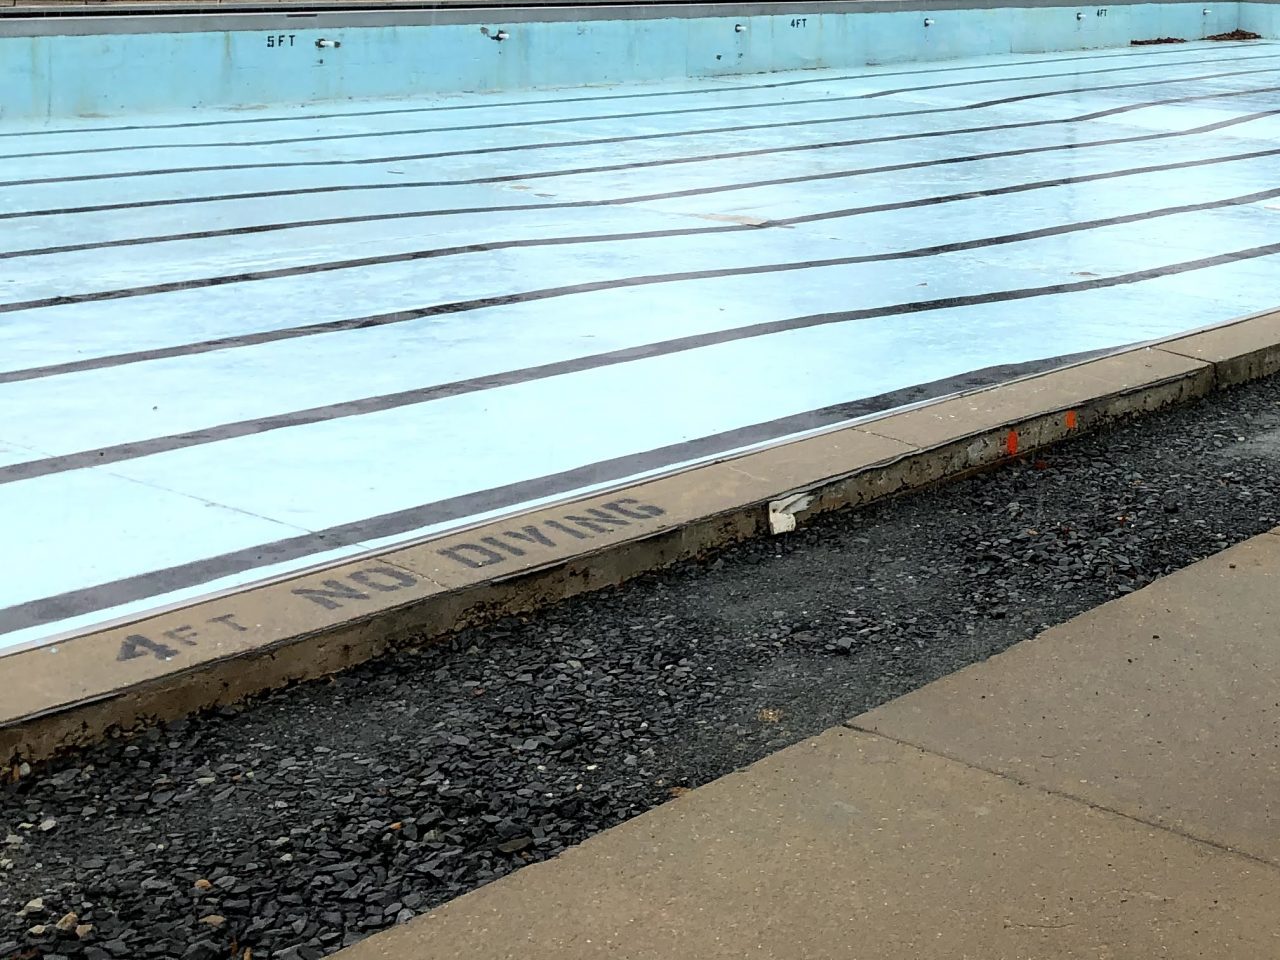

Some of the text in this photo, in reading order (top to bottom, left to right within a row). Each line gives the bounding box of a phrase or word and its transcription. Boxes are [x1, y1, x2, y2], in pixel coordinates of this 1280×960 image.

[1095, 8, 1108, 16] 4FT
[790, 17, 808, 29] 4FT
[267, 35, 295, 48] 5FT
[116, 498, 666, 662] 4FT NO DIVING
